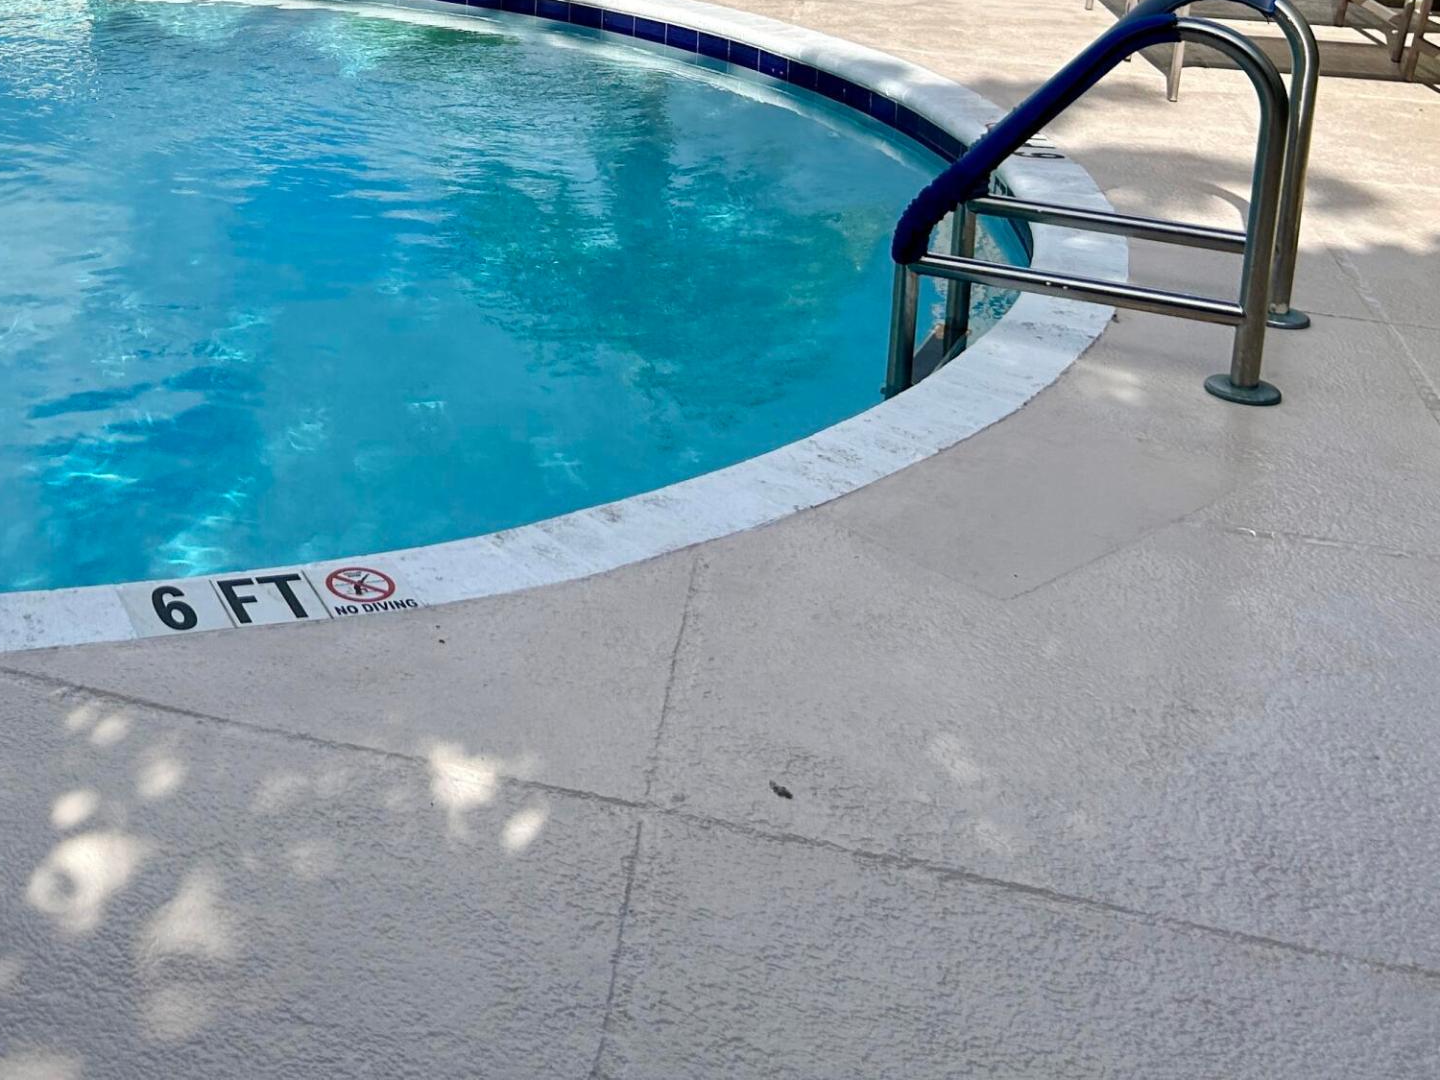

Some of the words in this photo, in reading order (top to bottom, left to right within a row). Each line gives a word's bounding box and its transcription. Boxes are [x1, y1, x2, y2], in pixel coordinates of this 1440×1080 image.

[151, 585, 198, 631] 6
[216, 573, 309, 624] FT
[334, 604, 359, 616] NO
[361, 598, 418, 613] DIVING
